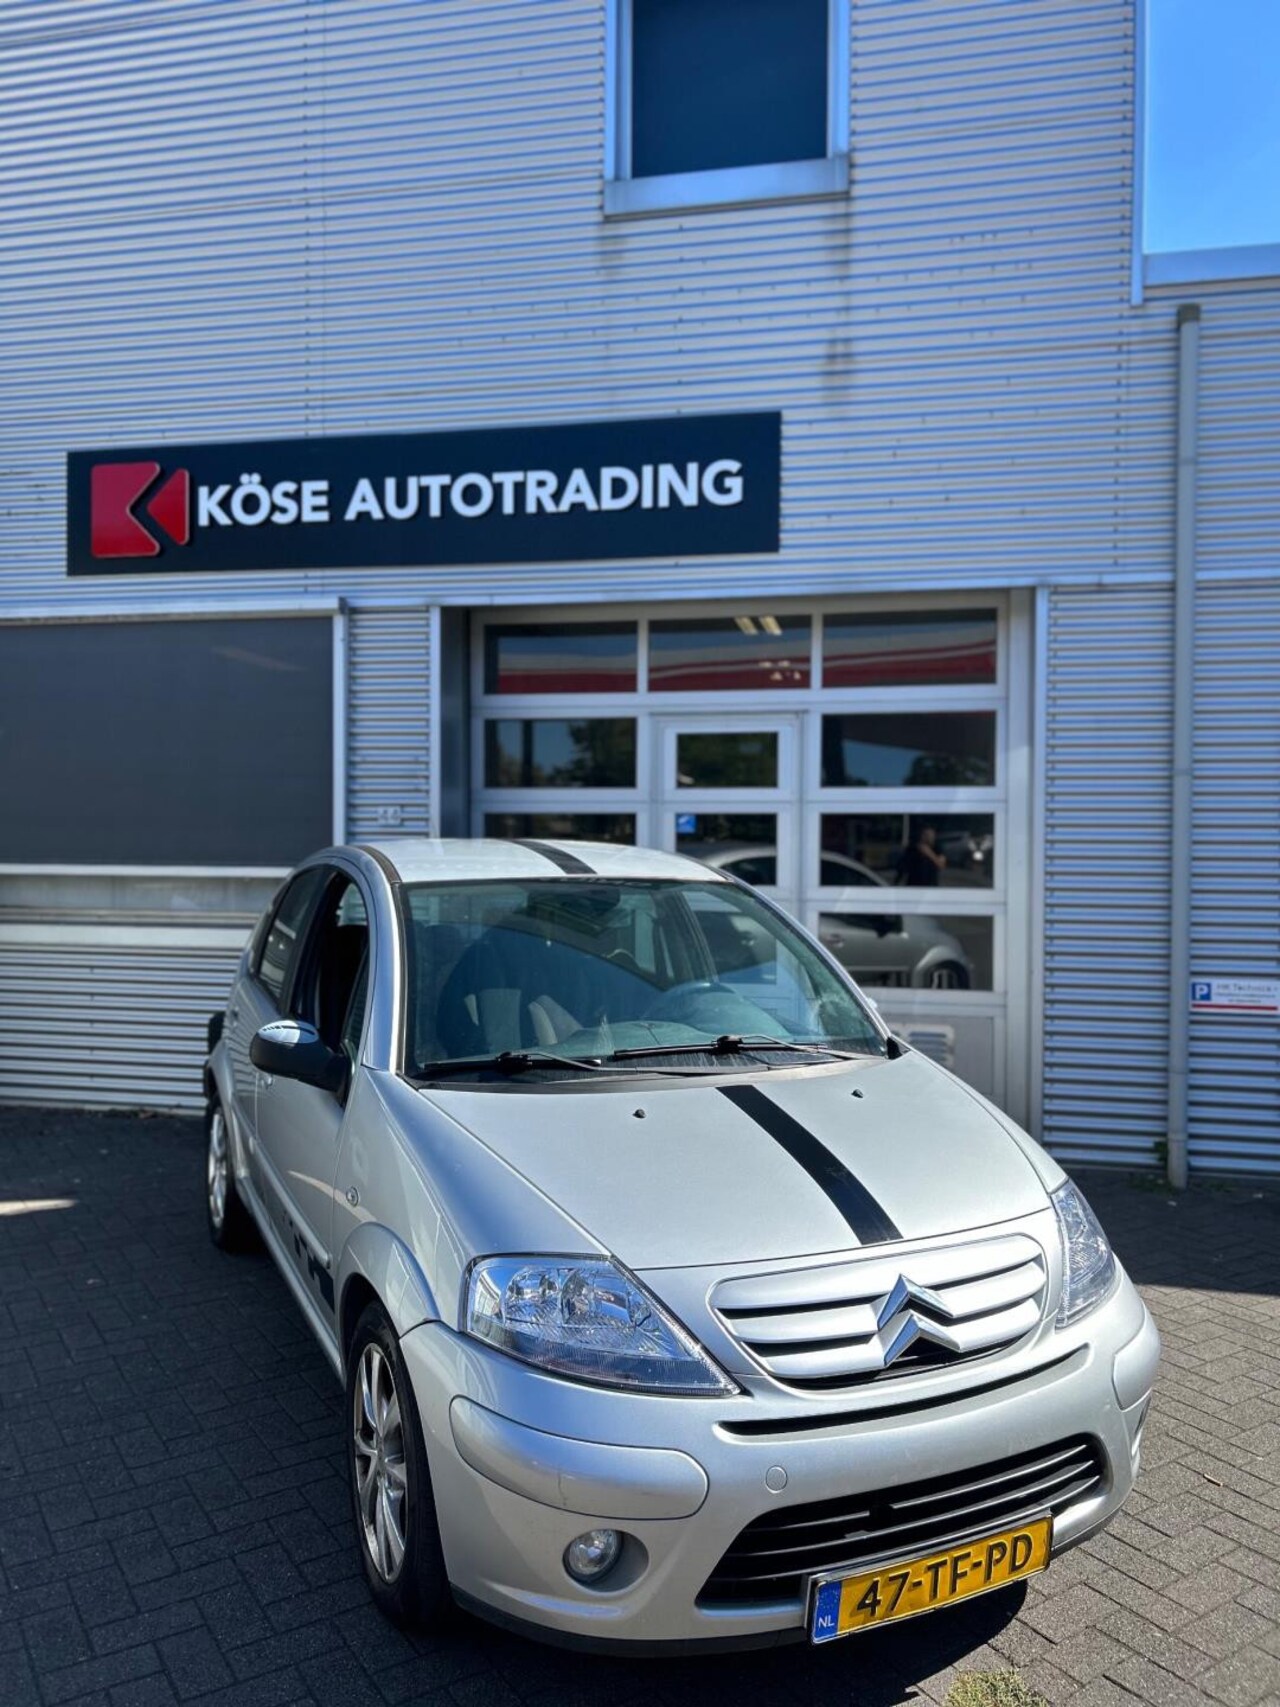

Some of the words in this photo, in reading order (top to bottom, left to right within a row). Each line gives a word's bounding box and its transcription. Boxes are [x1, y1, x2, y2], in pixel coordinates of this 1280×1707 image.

[198, 473, 329, 526] KÖSE
[344, 459, 743, 521] AUTOTRADING
[1195, 984, 1209, 1000] P
[856, 1533, 1033, 1617] 47-TF-PD
[818, 1615, 835, 1628] NL
